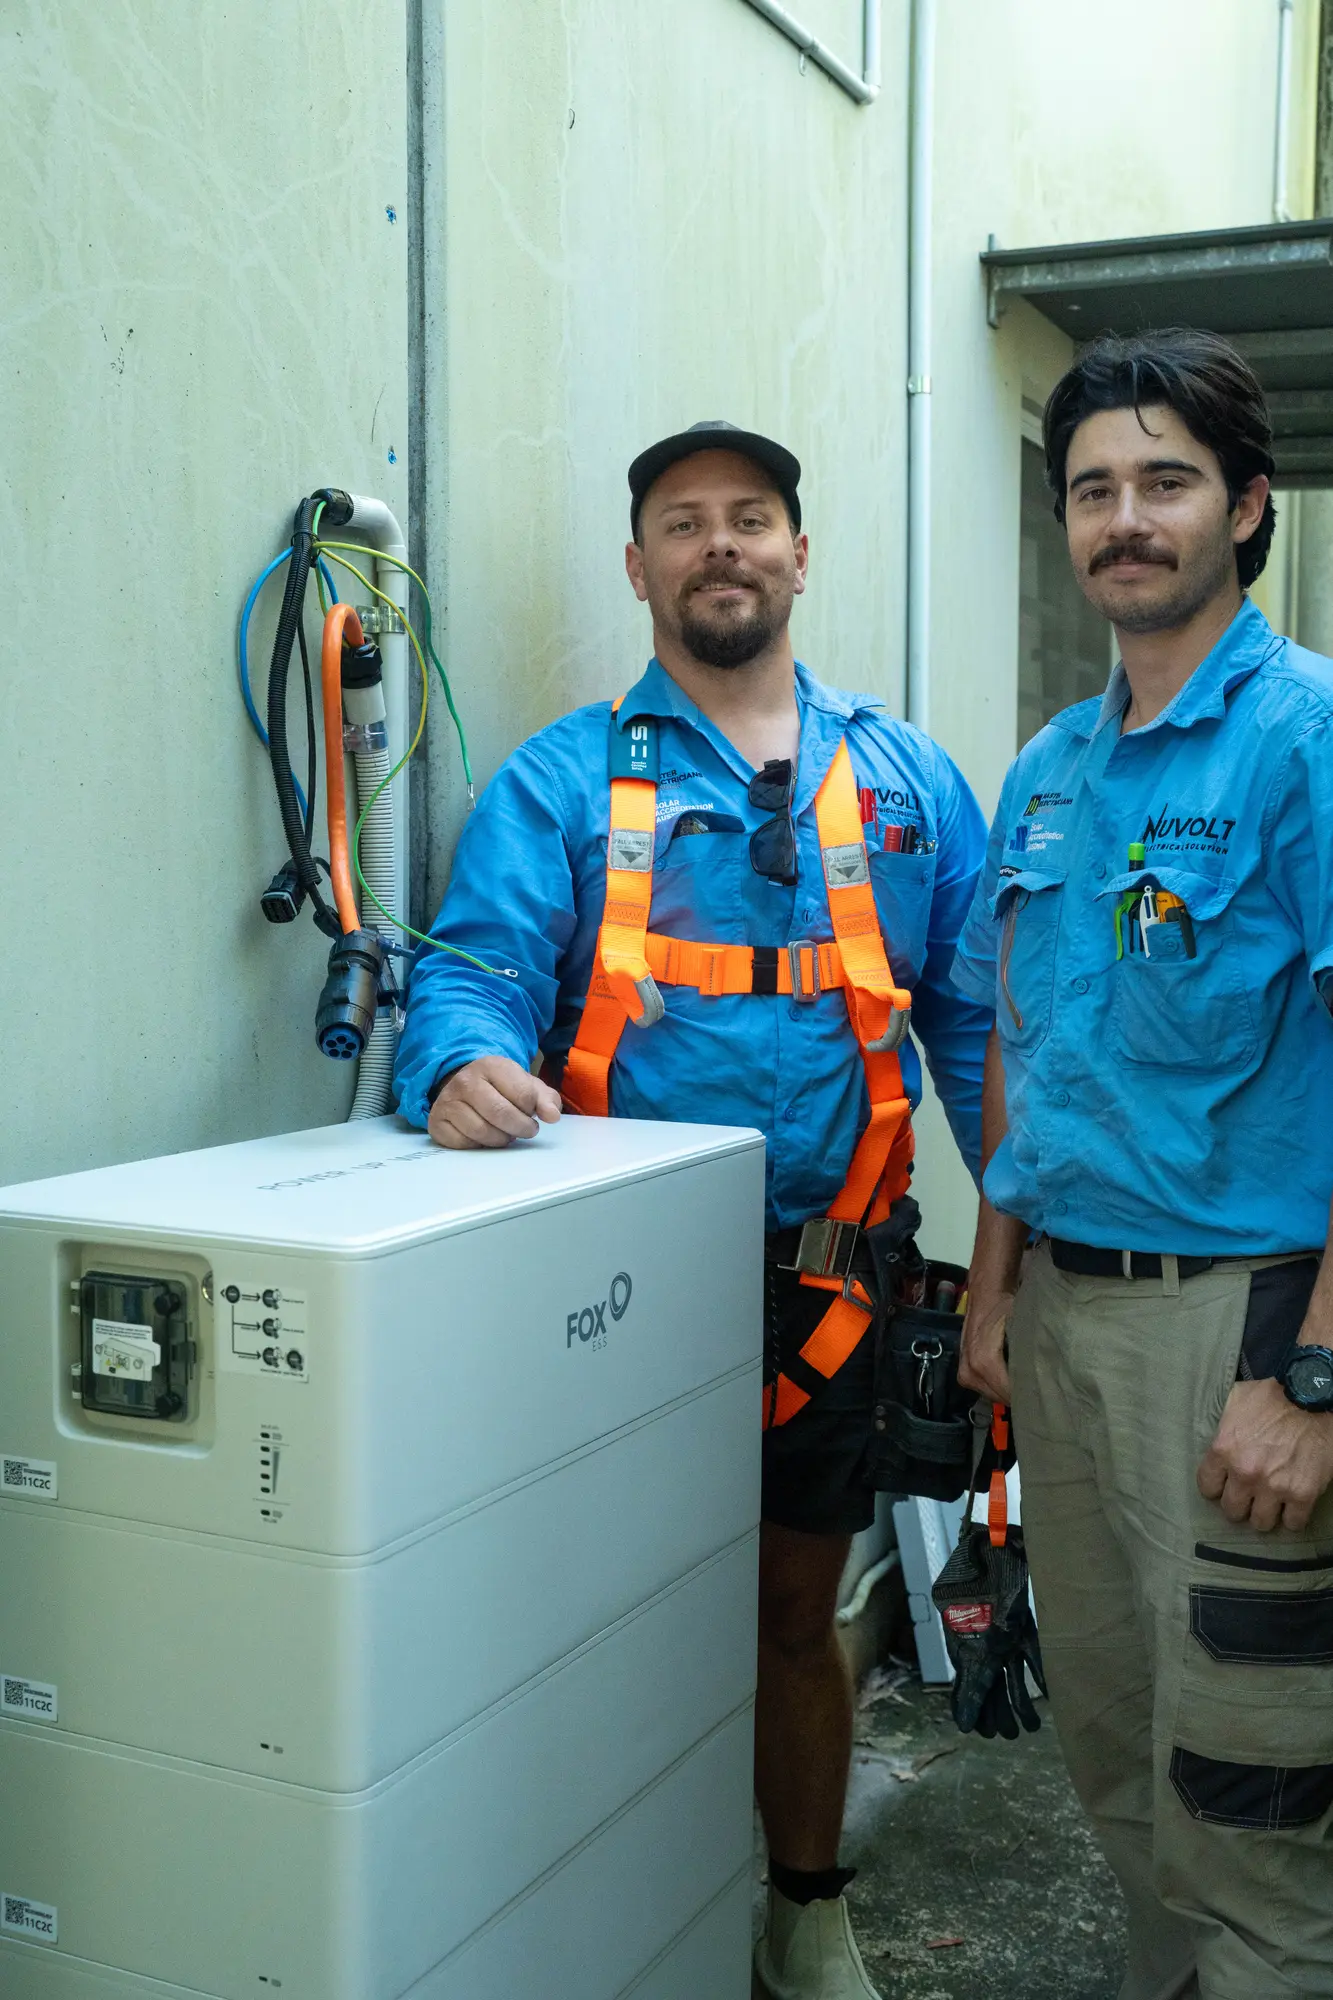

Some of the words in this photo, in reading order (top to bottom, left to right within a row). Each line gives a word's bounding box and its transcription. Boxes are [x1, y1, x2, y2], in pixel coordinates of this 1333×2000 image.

[660, 771, 703, 785] CTRICIANS
[1142, 802, 1236, 844] NUVOLT
[256, 1170, 355, 1191] POWER
[350, 1161, 388, 1169] UP
[566, 1300, 607, 1349] FOX
[592, 1336, 608, 1352] ESS
[23, 1476, 51, 1490] 11C2C
[25, 1697, 52, 1713] 11C2C
[26, 1917, 53, 1934] 11C2C
